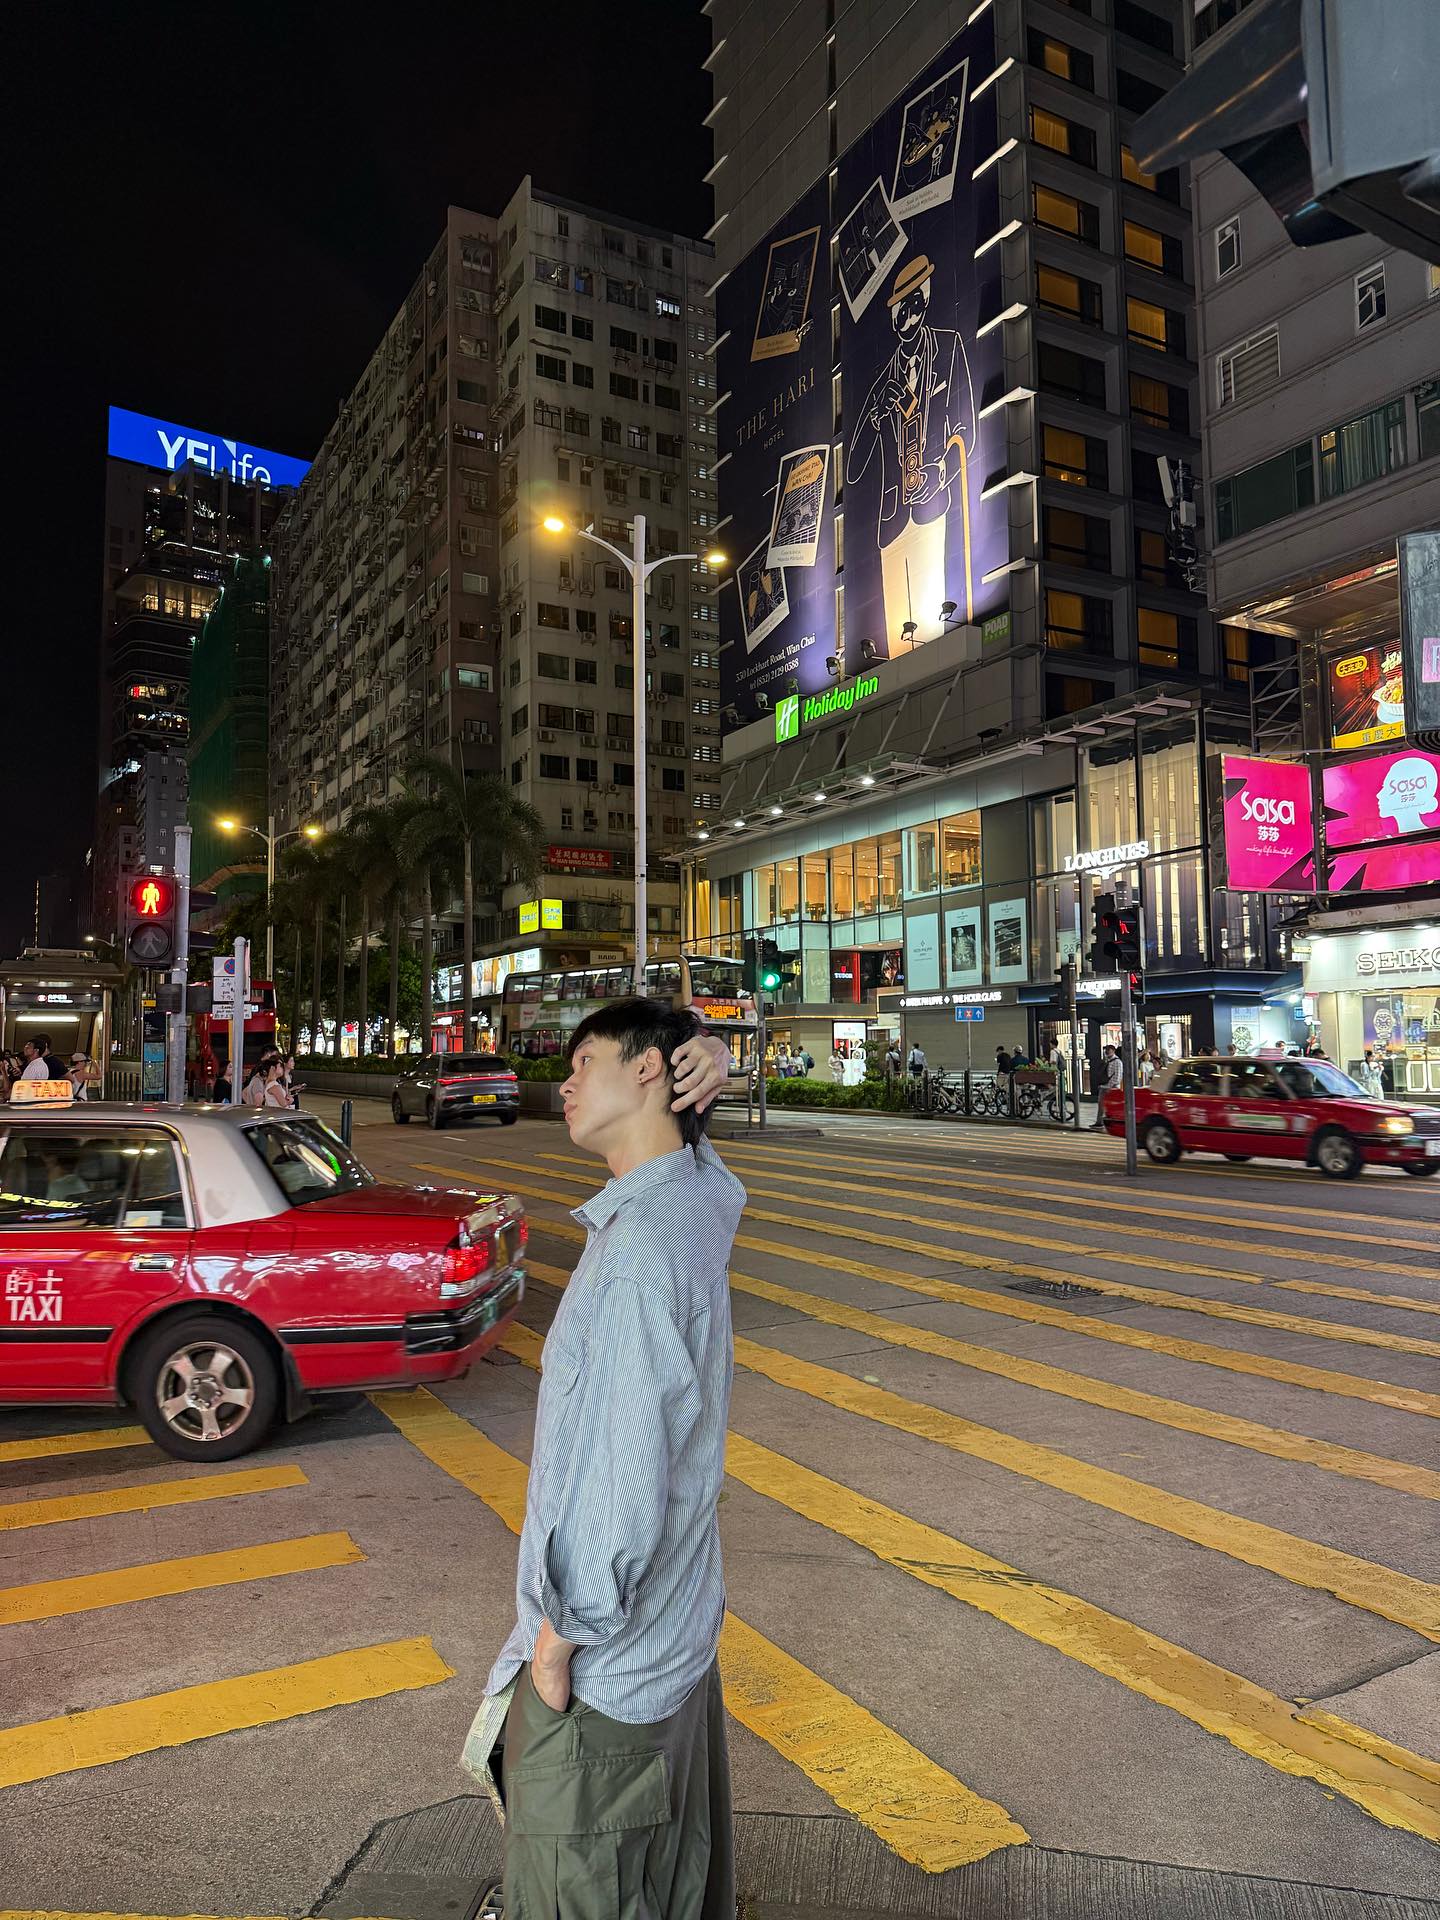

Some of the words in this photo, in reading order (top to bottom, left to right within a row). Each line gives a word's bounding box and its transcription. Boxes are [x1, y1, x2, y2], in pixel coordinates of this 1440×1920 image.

[737, 407, 767, 446] THE
[773, 367, 815, 418] HARI
[763, 429, 785, 450] HOTEL
[787, 643, 801, 657] Wan
[801, 632, 816, 649] Chai
[804, 687, 855, 722] Holiday
[856, 676, 879, 700] Inn
[1257, 825, 1280, 842] 莎莎
[1063, 840, 1149, 873] LONGINES
[981, 991, 1002, 1002] GLASS
[31, 1081, 72, 1098] TAXI
[5, 1268, 64, 1295] 的士
[5, 1295, 63, 1322] TAXI
